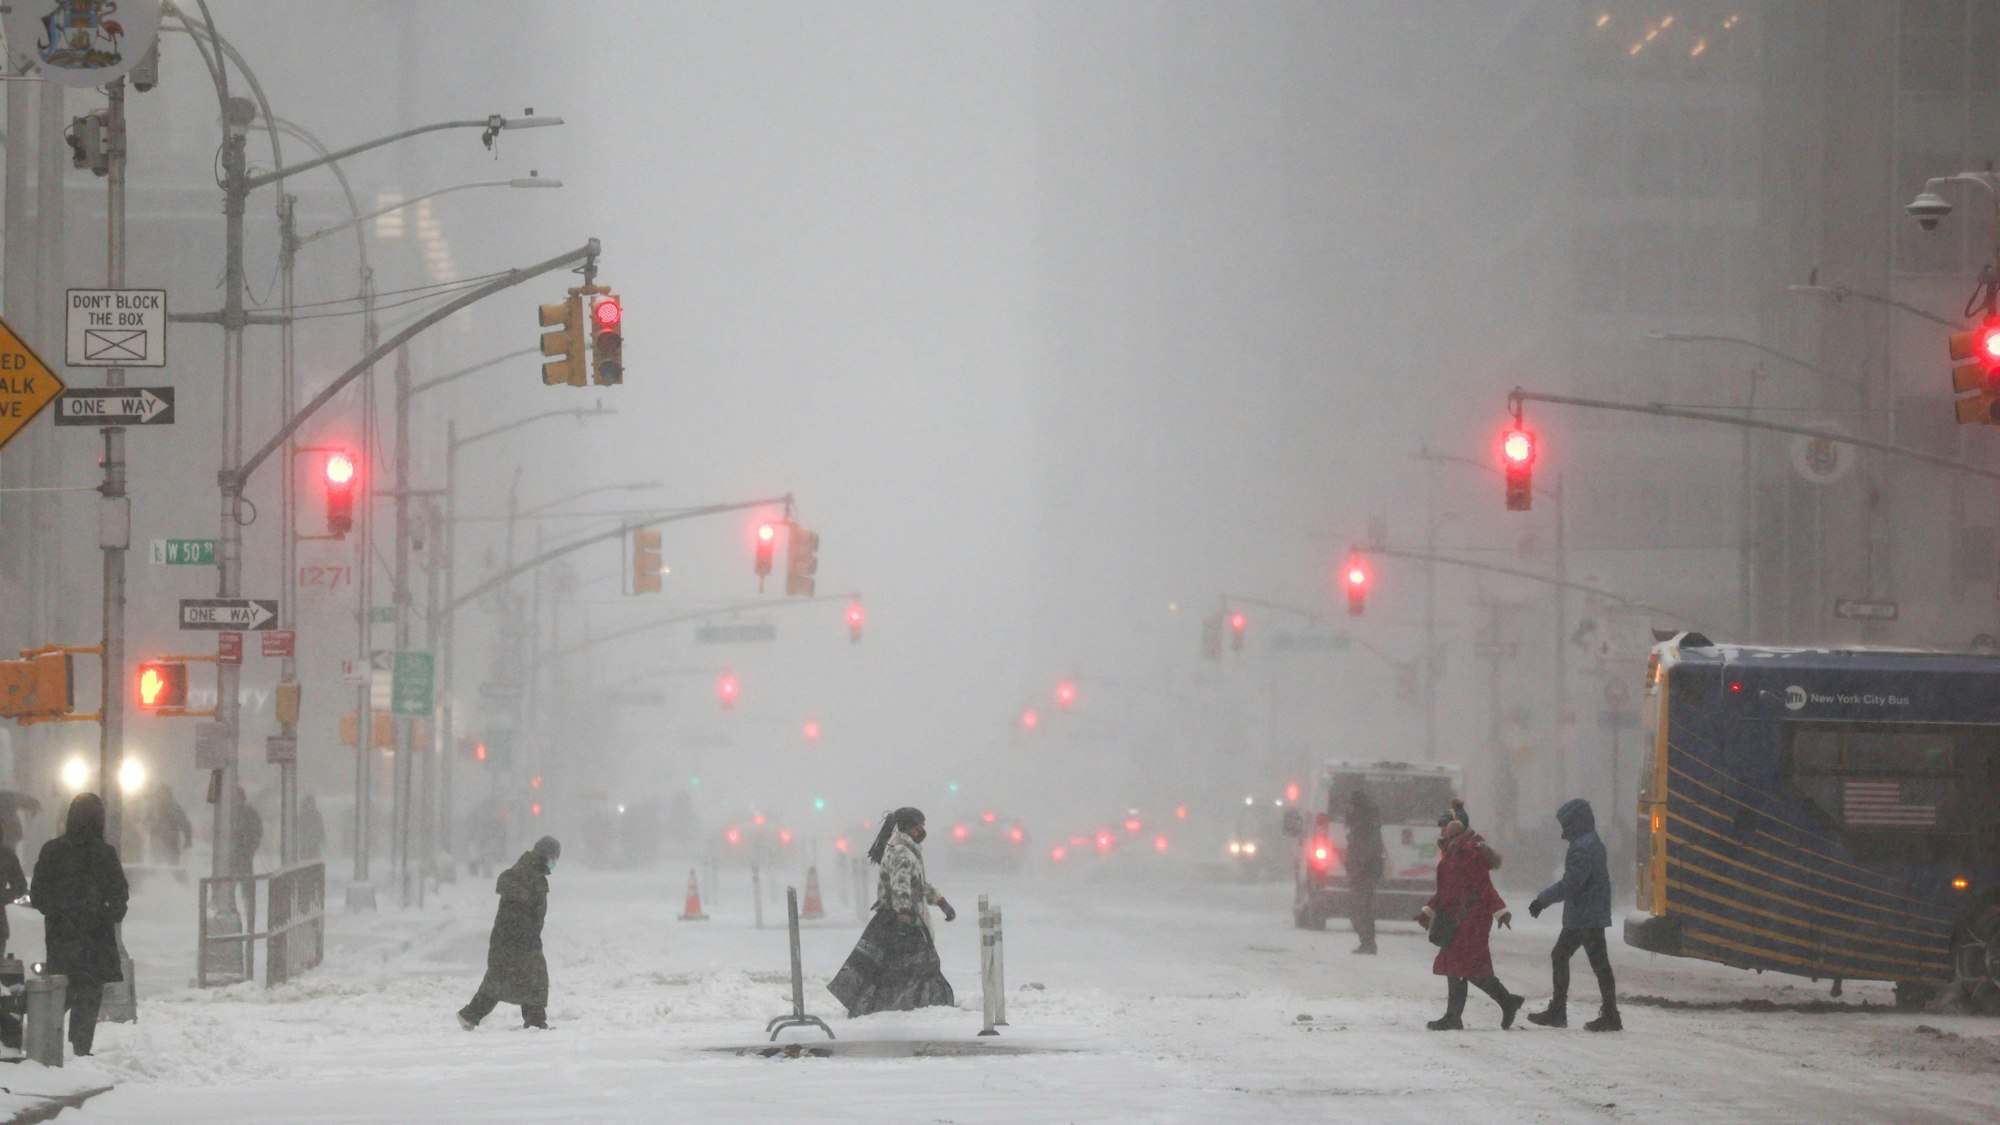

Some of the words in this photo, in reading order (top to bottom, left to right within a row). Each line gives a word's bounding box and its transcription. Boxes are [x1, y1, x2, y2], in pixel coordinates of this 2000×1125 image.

[73, 295, 111, 309] DON'T
[116, 295, 159, 309] BLOCK
[89, 312, 113, 325] THE
[118, 312, 144, 326] BOX
[2, 353, 26, 369] ED
[0, 377, 35, 394] ALK
[71, 400, 106, 414] ONE
[121, 399, 157, 414] WAY
[167, 543, 178, 561] W
[183, 542, 200, 561] 50
[300, 566, 351, 590] 1271
[189, 608, 216, 621] ONE
[230, 608, 259, 621] WAY
[1810, 693, 1834, 703] New
[1837, 694, 1860, 704] York
[1863, 694, 1886, 706] City
[1888, 695, 1909, 705] Bus
